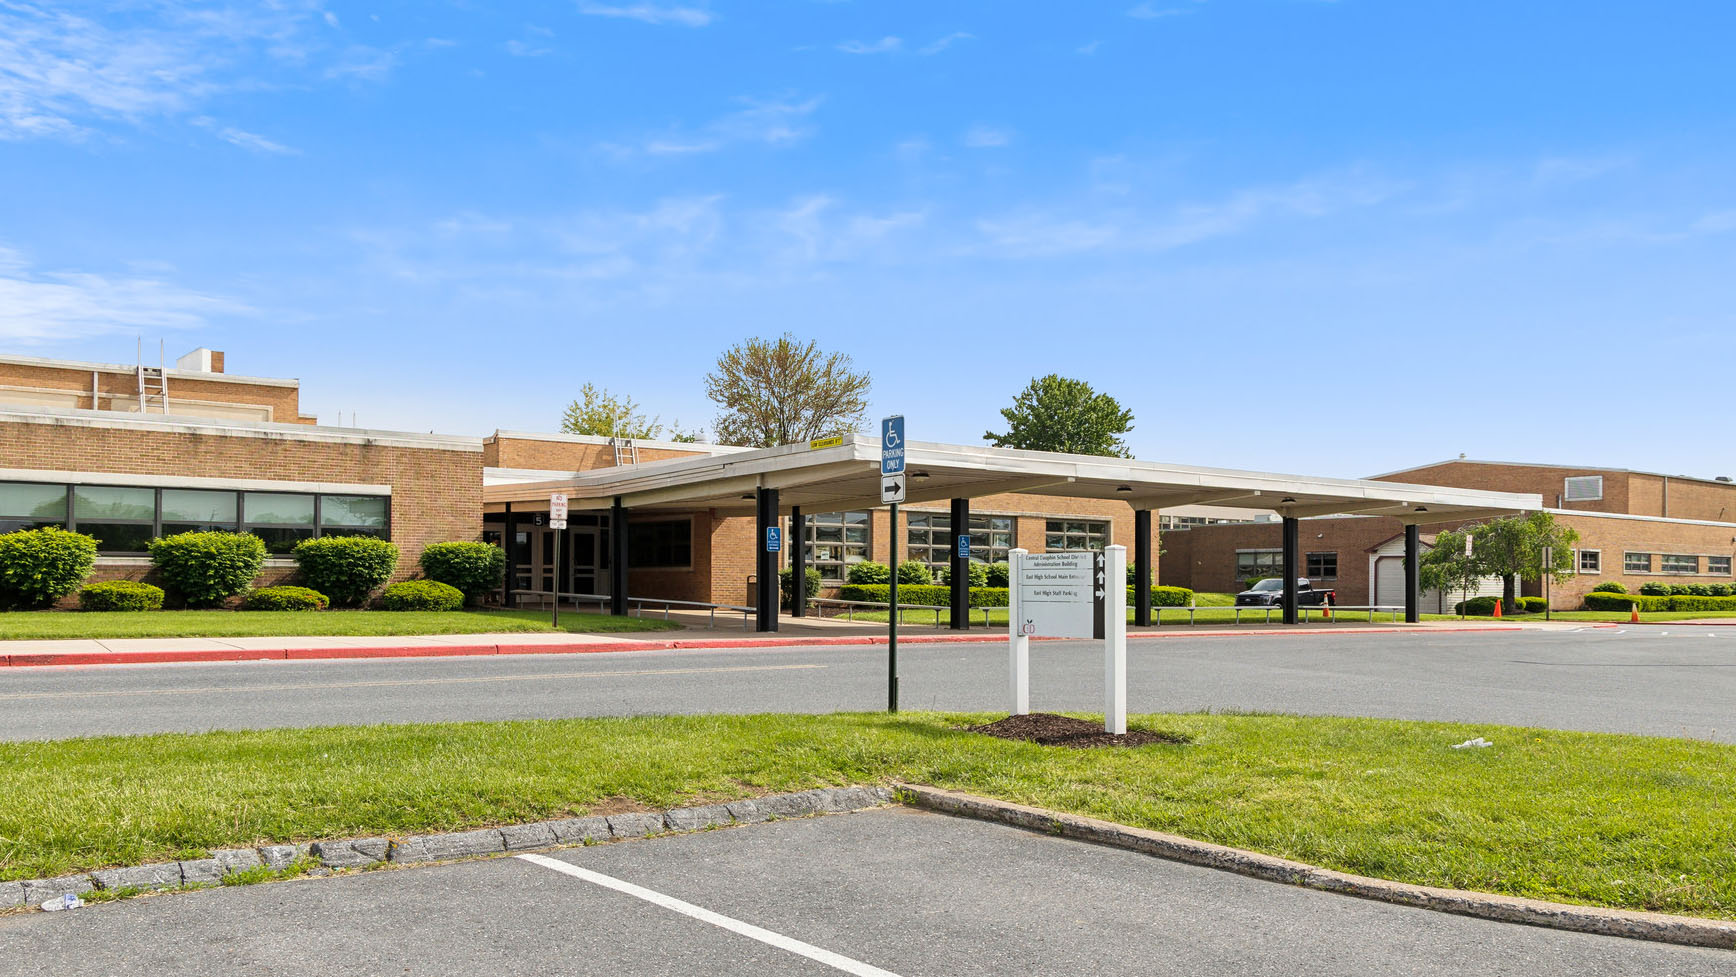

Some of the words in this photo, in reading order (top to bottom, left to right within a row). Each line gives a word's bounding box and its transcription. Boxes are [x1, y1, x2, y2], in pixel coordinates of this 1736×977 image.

[882, 448, 904, 459] PARKING
[886, 458, 900, 470] ONLY
[535, 517, 542, 525] 5
